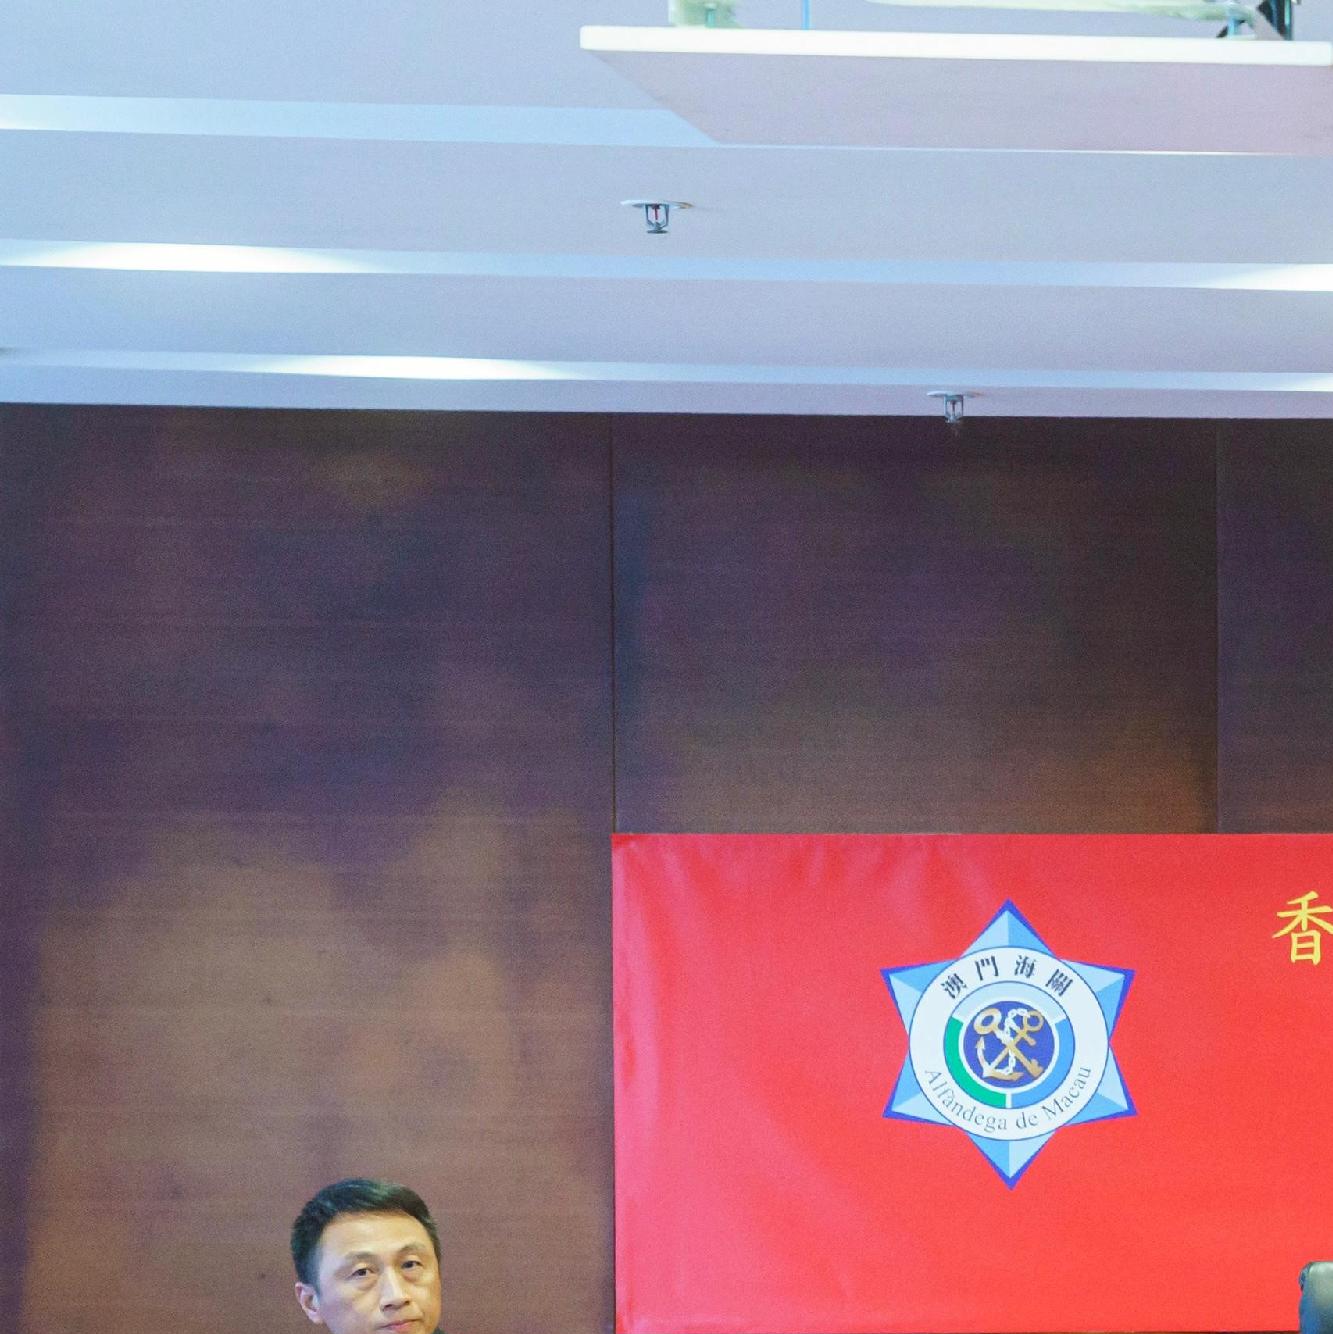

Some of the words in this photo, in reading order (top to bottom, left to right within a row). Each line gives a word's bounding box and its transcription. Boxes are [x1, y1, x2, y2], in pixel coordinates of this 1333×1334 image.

[941, 954, 1074, 999] 澳門海關
[1015, 1110, 1038, 1131] de
[1045, 1065, 1092, 1122] Macau
